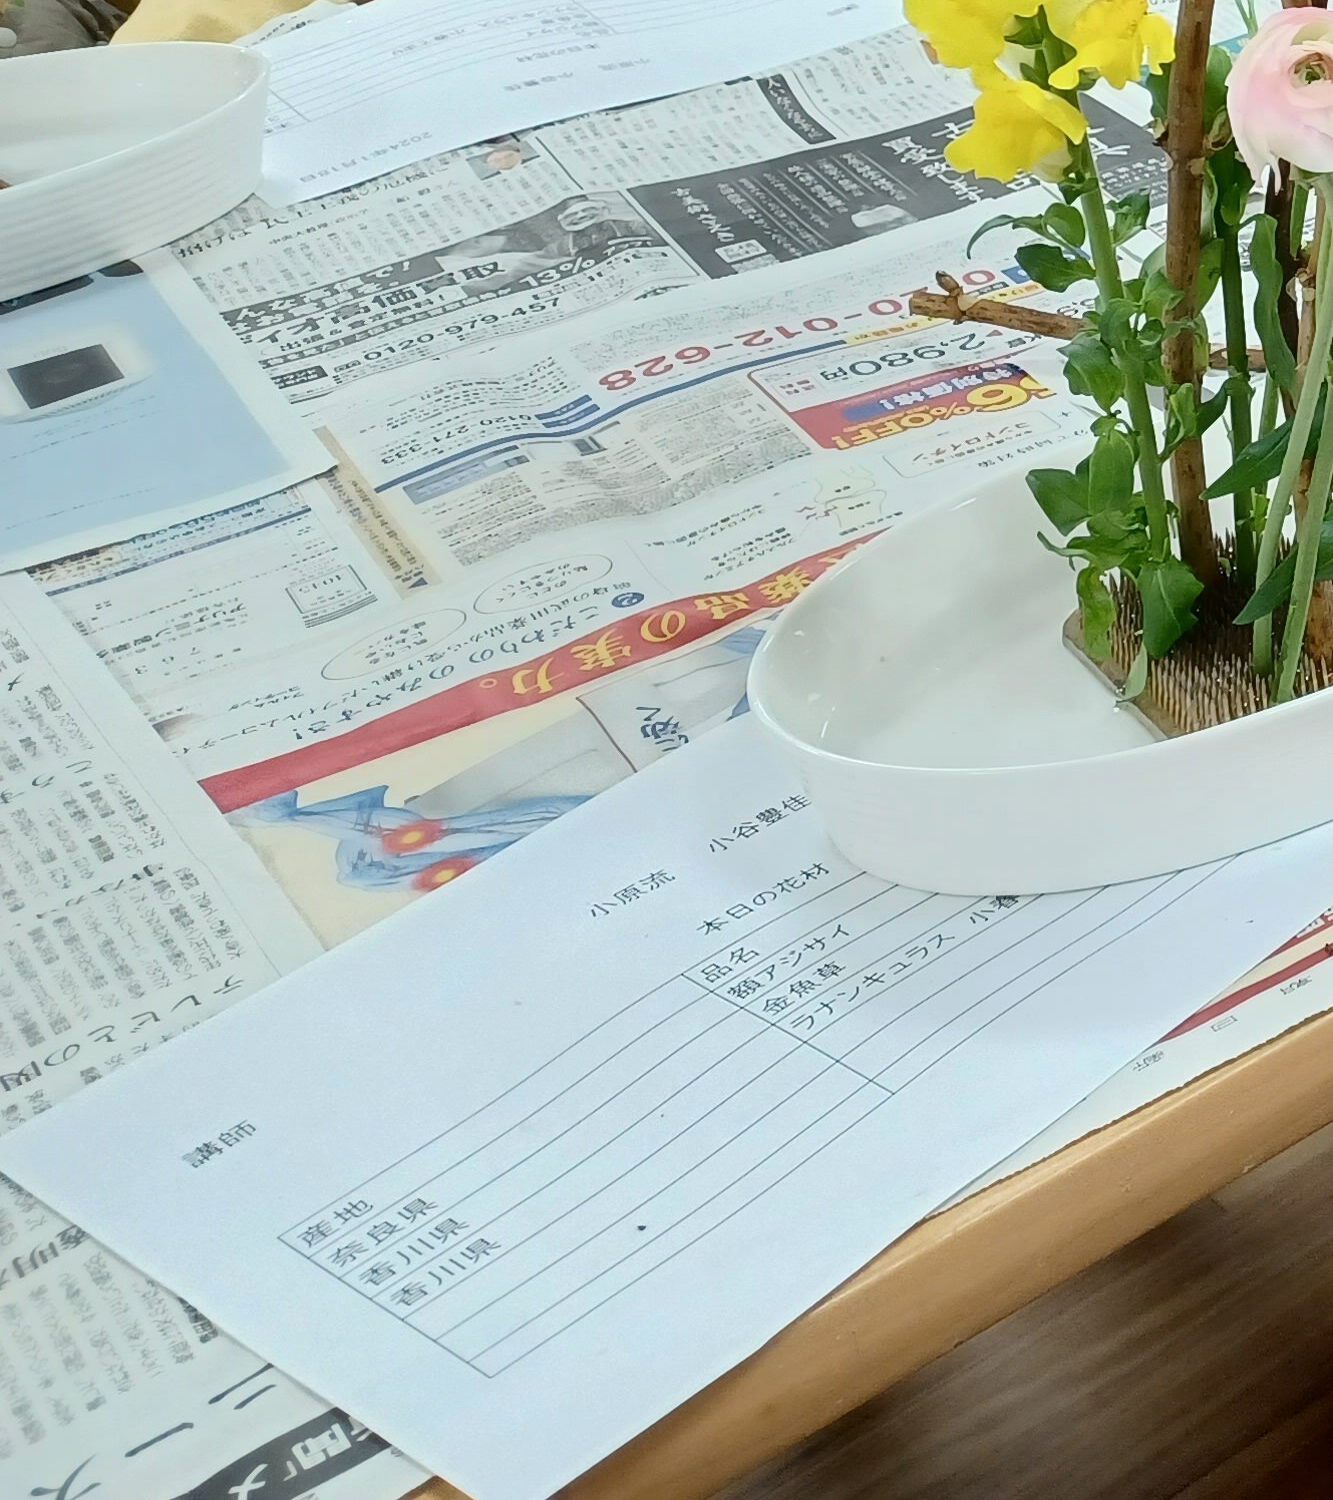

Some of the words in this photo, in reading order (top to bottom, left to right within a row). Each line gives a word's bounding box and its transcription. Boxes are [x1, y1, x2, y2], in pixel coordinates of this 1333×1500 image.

[361, 297, 564, 362] 0120-979-457
[597, 266, 996, 392] 00-012-628
[819, 332, 985, 386] 2,980円
[465, 603, 601, 668] こだわりの
[290, 661, 456, 741] のみやすさ!
[588, 866, 678, 921] 小原流
[696, 862, 832, 937] 本日の花材
[702, 944, 761, 984] 品名
[727, 922, 853, 1001] 額アジサイ
[762, 960, 848, 1018] 金魚草
[789, 930, 957, 1032] ラナンキュラス
[181, 1119, 258, 1171] 講師
[301, 1198, 374, 1249] 産地
[329, 1197, 439, 1268] 奈良県
[359, 1217, 469, 1287] 香川県
[390, 1237, 503, 1307] 香川県
